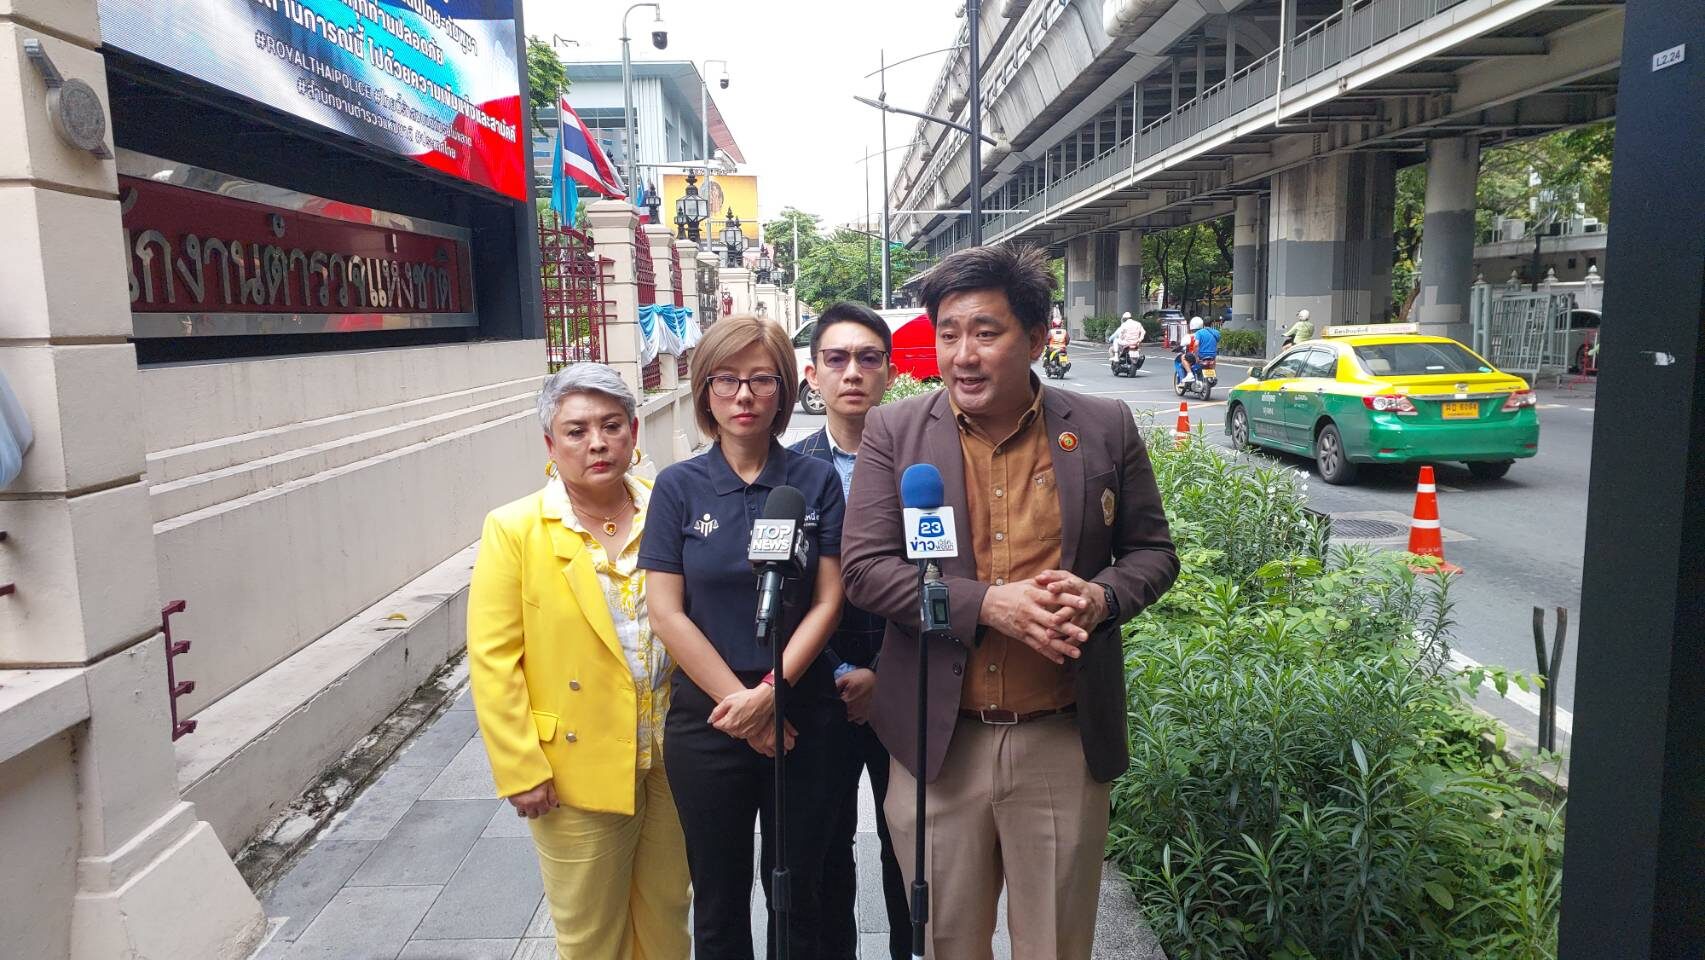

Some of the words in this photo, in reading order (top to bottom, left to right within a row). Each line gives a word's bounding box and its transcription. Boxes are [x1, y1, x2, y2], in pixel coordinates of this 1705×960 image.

[254, 30, 372, 98] #ROYALTHAIPOLICE
[756, 524, 792, 540] TOP
[920, 522, 941, 534] 23
[752, 540, 790, 551] NEWS
[910, 536, 936, 551] ข่าว
